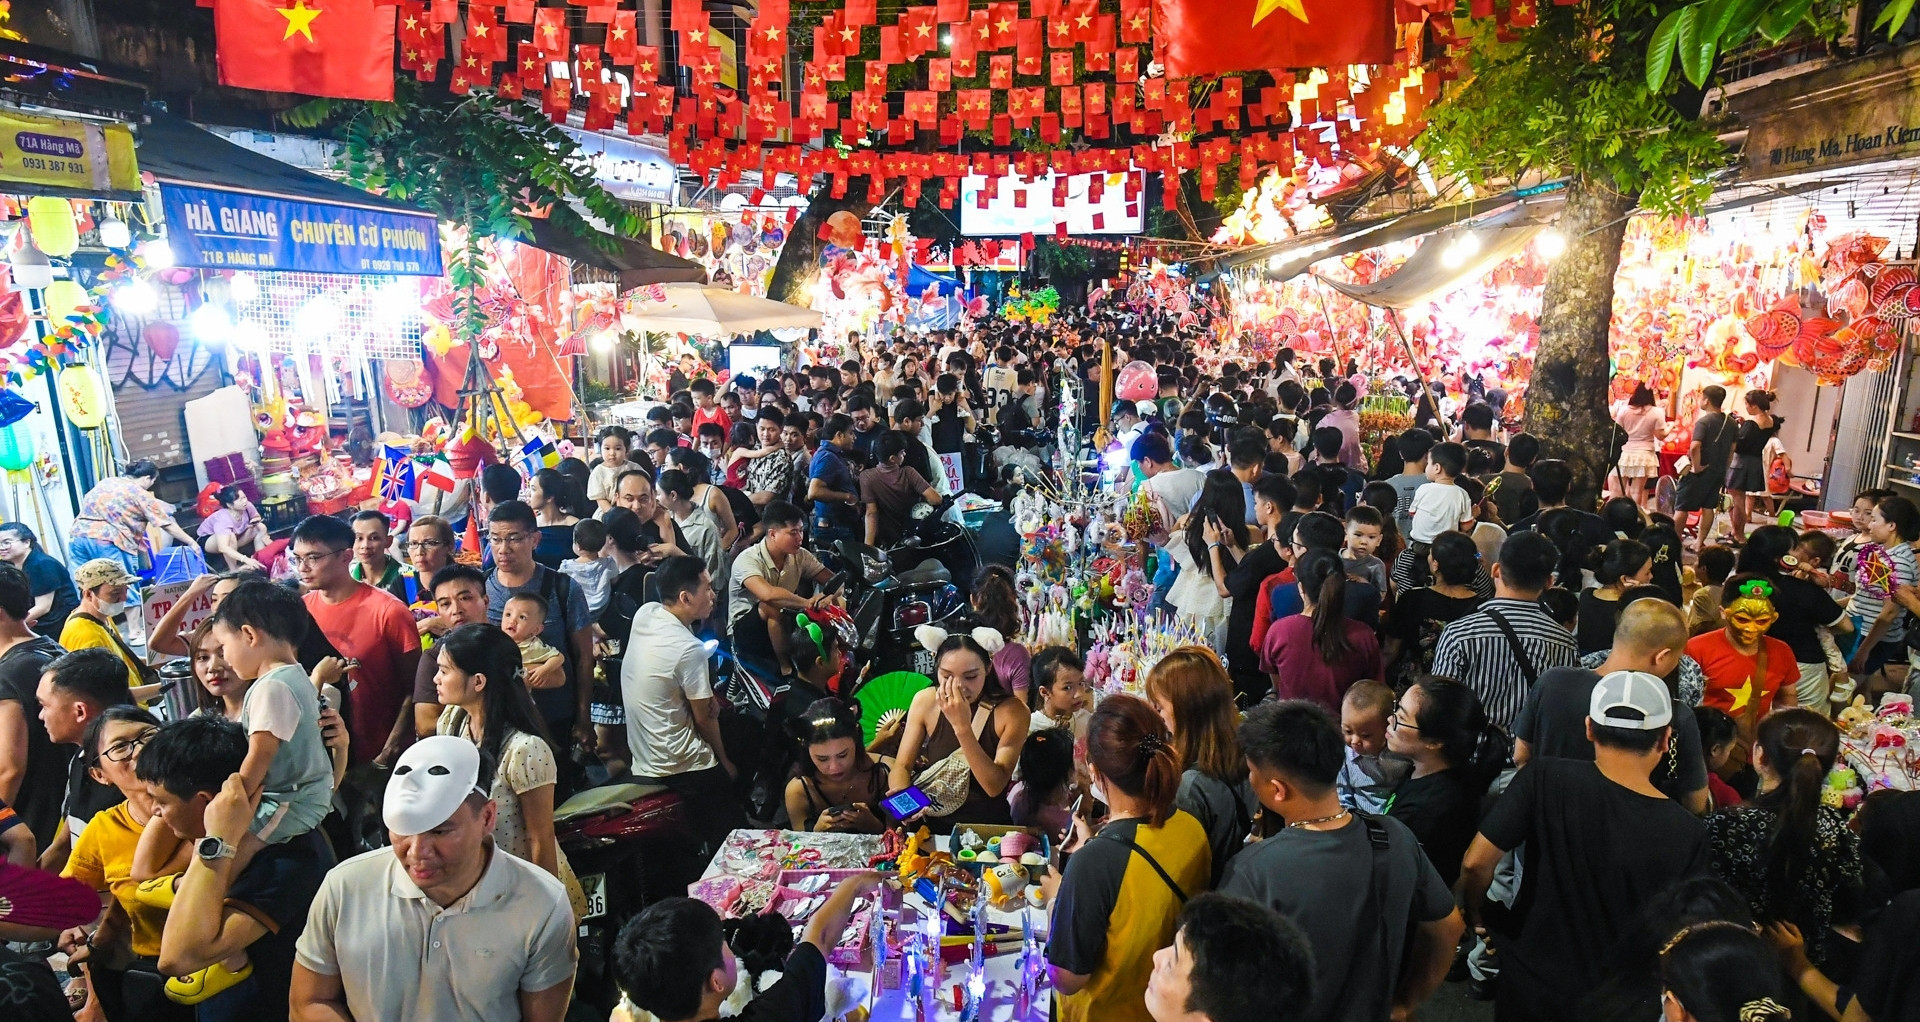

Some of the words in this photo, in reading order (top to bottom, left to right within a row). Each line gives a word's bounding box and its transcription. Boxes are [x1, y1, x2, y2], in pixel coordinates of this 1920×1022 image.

[19, 136, 39, 149] 71A
[40, 139, 65, 154] Hàng
[66, 140, 81, 154] Mã
[1784, 145, 1816, 165] Hang
[1844, 133, 1882, 153] Hoan
[22, 157, 46, 170] 0931
[48, 160, 65, 172] 387
[68, 162, 85, 174] 931
[184, 199, 217, 232] HÀ
[220, 206, 279, 237] GIANG
[290, 218, 357, 246] CHUYÊN
[358, 222, 379, 248] CỜ
[202, 250, 224, 264] 71B
[227, 249, 256, 266] HÀNG
[587, 895, 603, 916] 86
